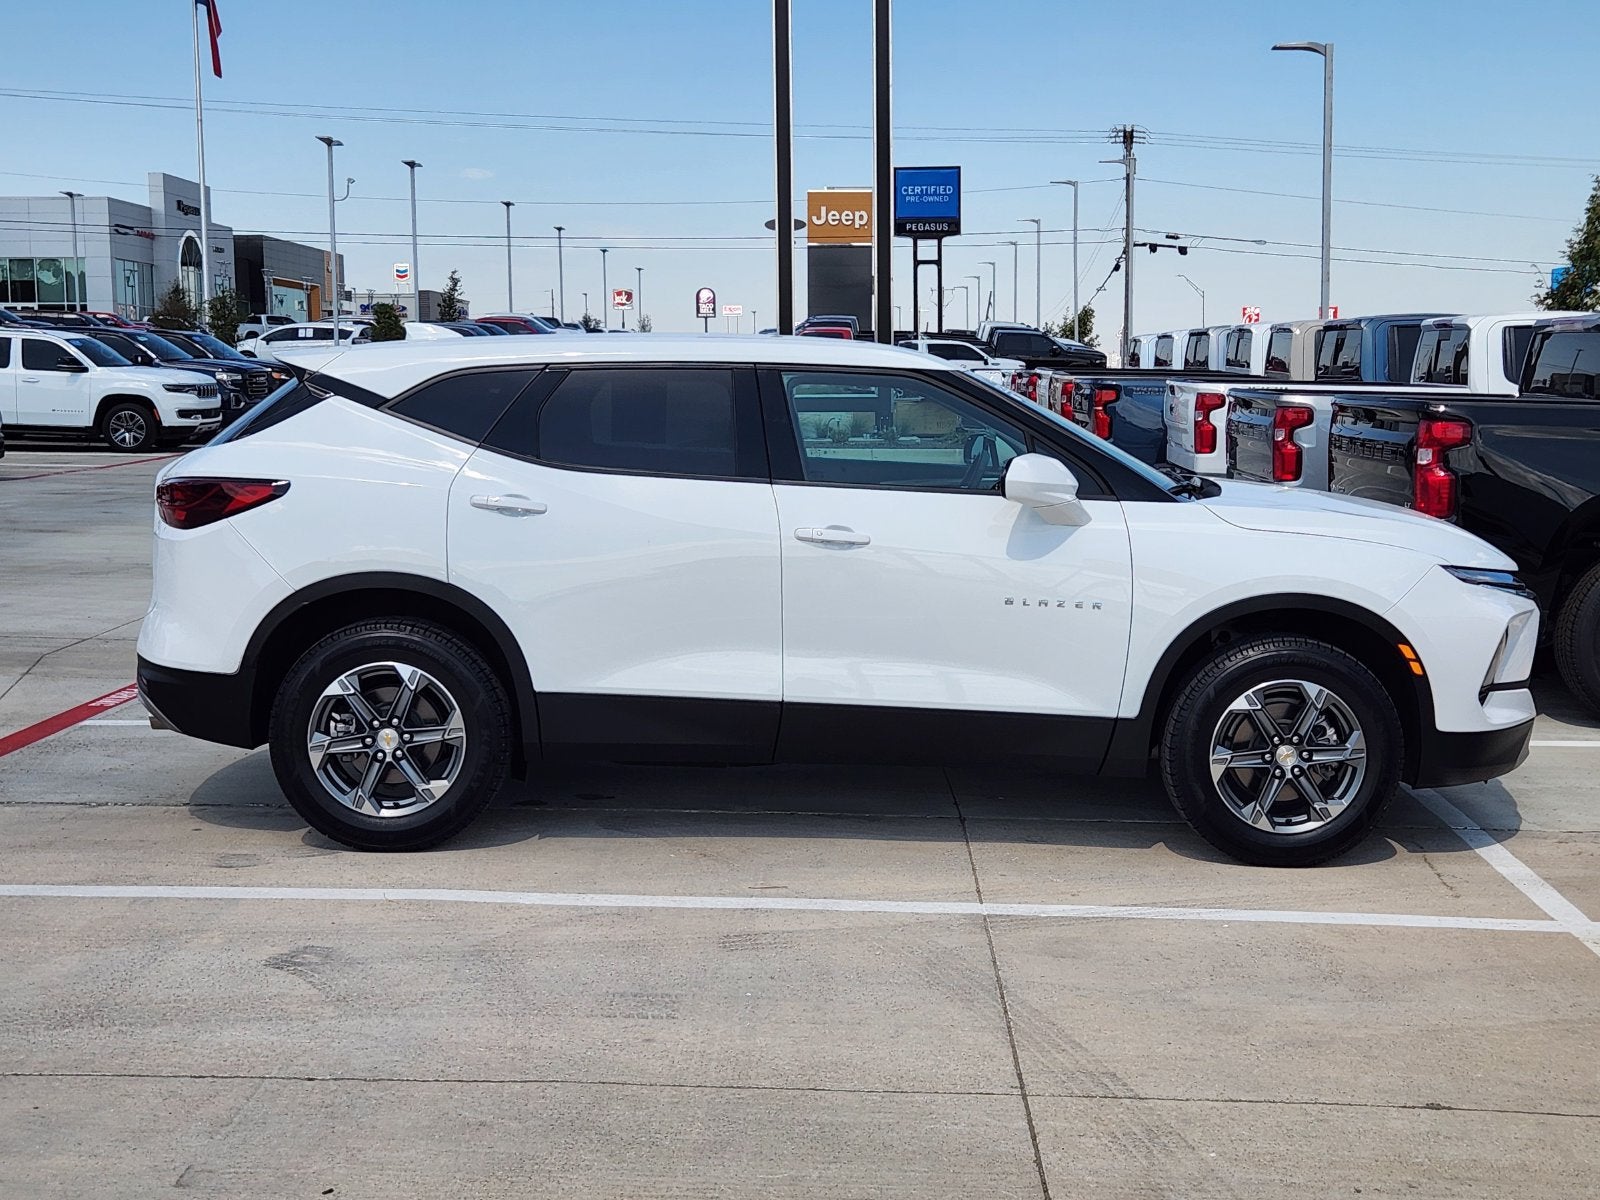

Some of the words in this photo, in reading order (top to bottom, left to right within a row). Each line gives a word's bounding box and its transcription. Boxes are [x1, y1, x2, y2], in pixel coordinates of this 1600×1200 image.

[901, 185, 954, 195] CERTIFIED
[905, 195, 949, 203] PRE-OWNED
[811, 205, 869, 229] Jeep
[906, 222, 949, 231] PEGASUS
[1004, 597, 1103, 610] BLAZER
